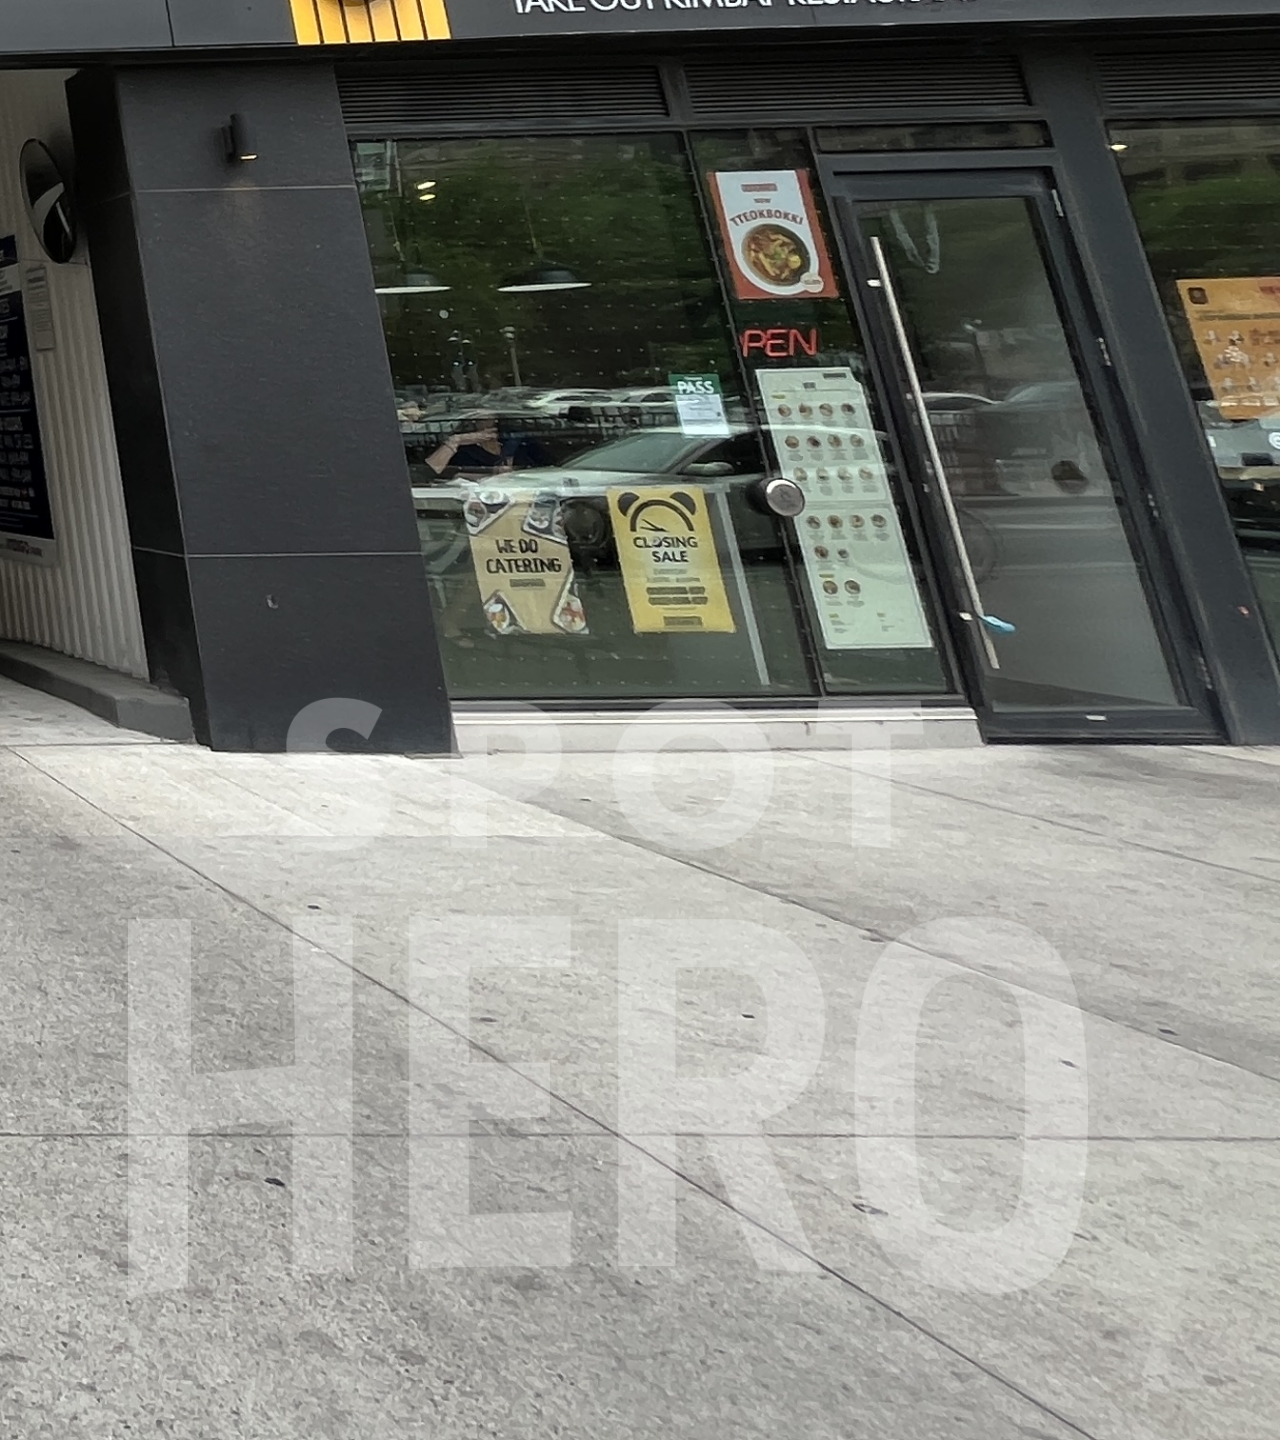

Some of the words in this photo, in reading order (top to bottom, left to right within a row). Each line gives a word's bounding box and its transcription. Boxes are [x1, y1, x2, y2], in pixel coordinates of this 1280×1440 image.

[739, 327, 819, 358] PEN
[677, 380, 715, 394] PASS
[495, 539, 515, 554] WE
[518, 538, 538, 554] DO
[632, 536, 699, 549] CLOSING
[651, 550, 689, 563] SALE
[486, 558, 562, 574] CATERING
